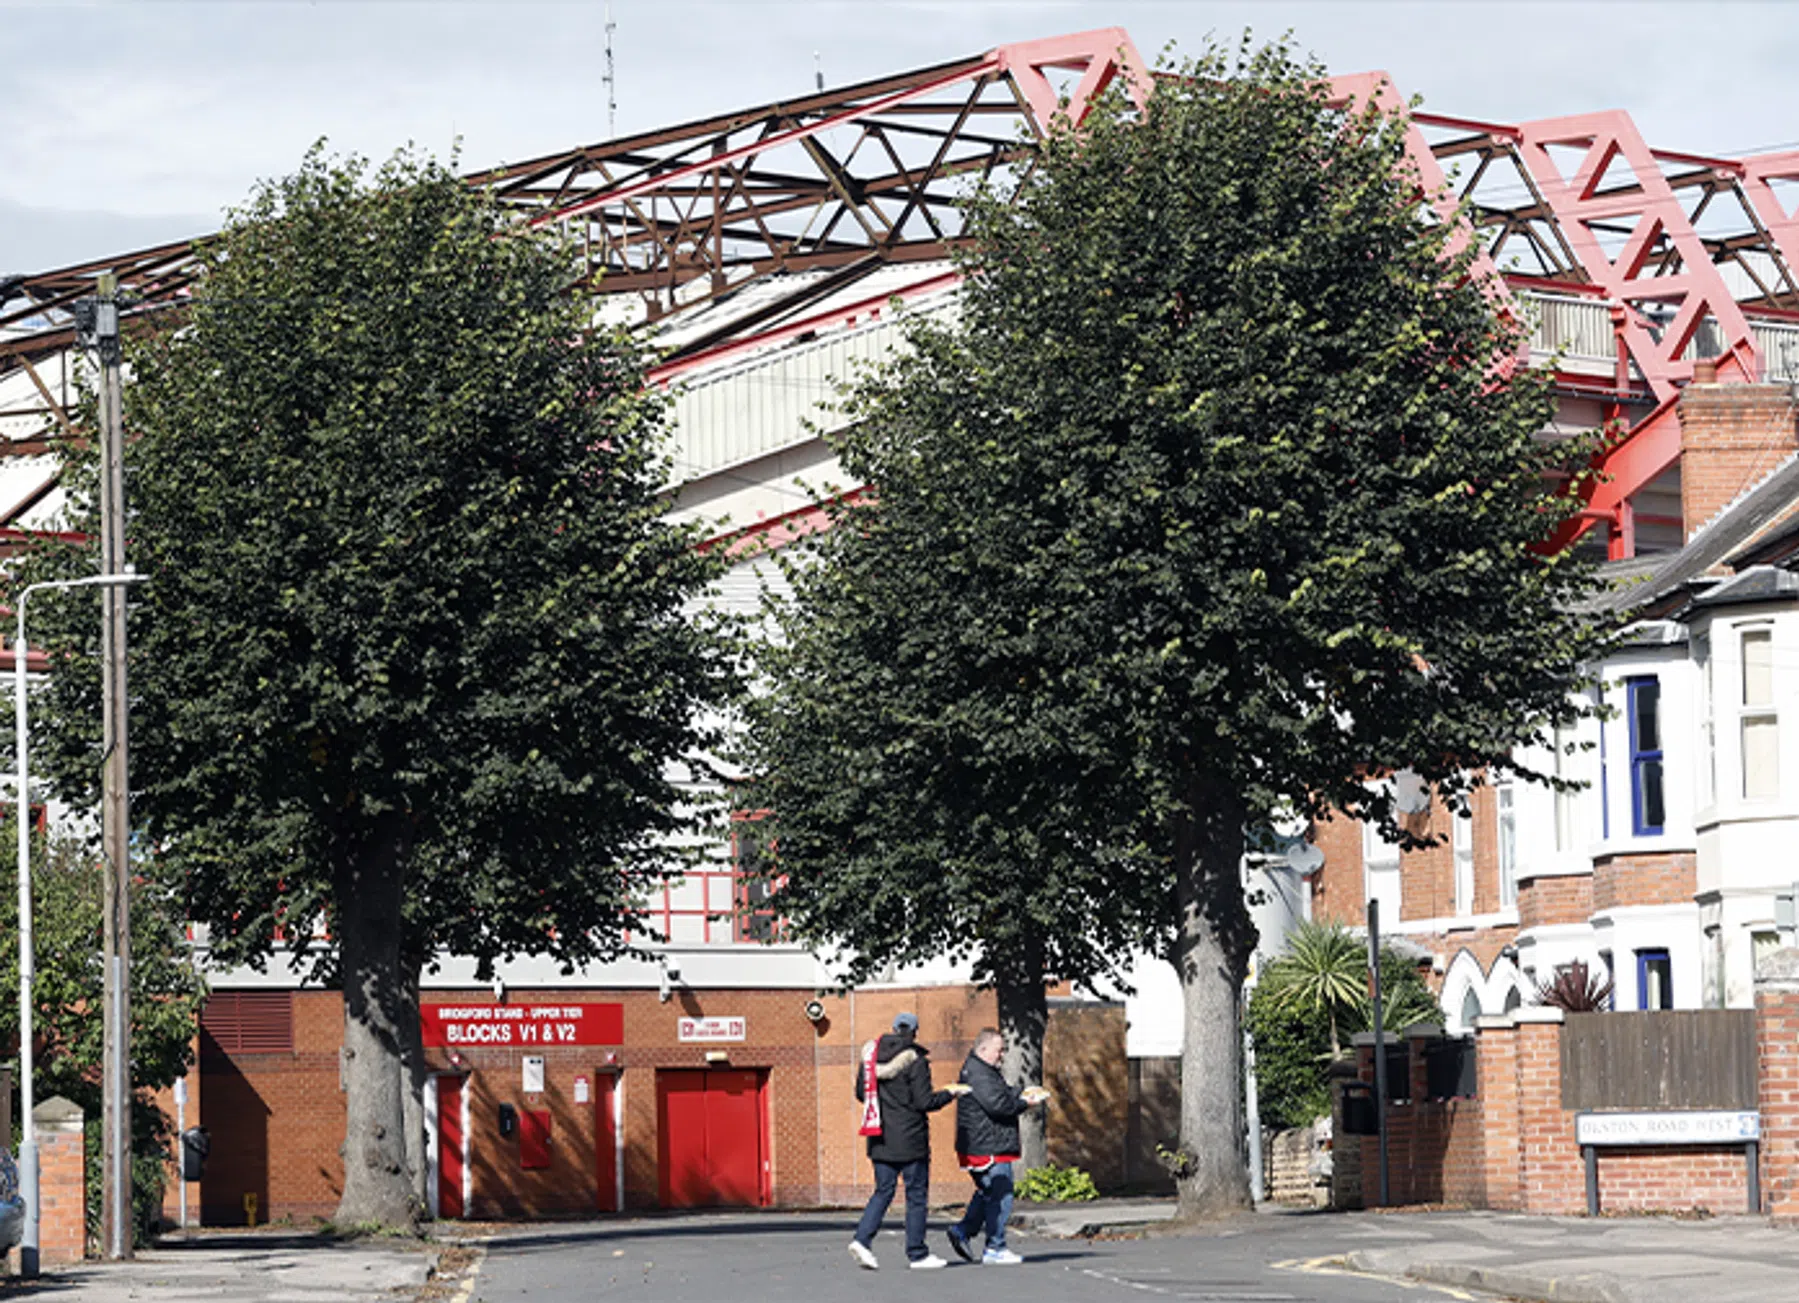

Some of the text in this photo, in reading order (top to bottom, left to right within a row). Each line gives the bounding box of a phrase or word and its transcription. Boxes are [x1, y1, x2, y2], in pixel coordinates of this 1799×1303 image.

[447, 1024, 576, 1042] BLOCKS V1 & V2
[1647, 1119, 1689, 1133] ROAD
[1696, 1117, 1732, 1132] WEST
